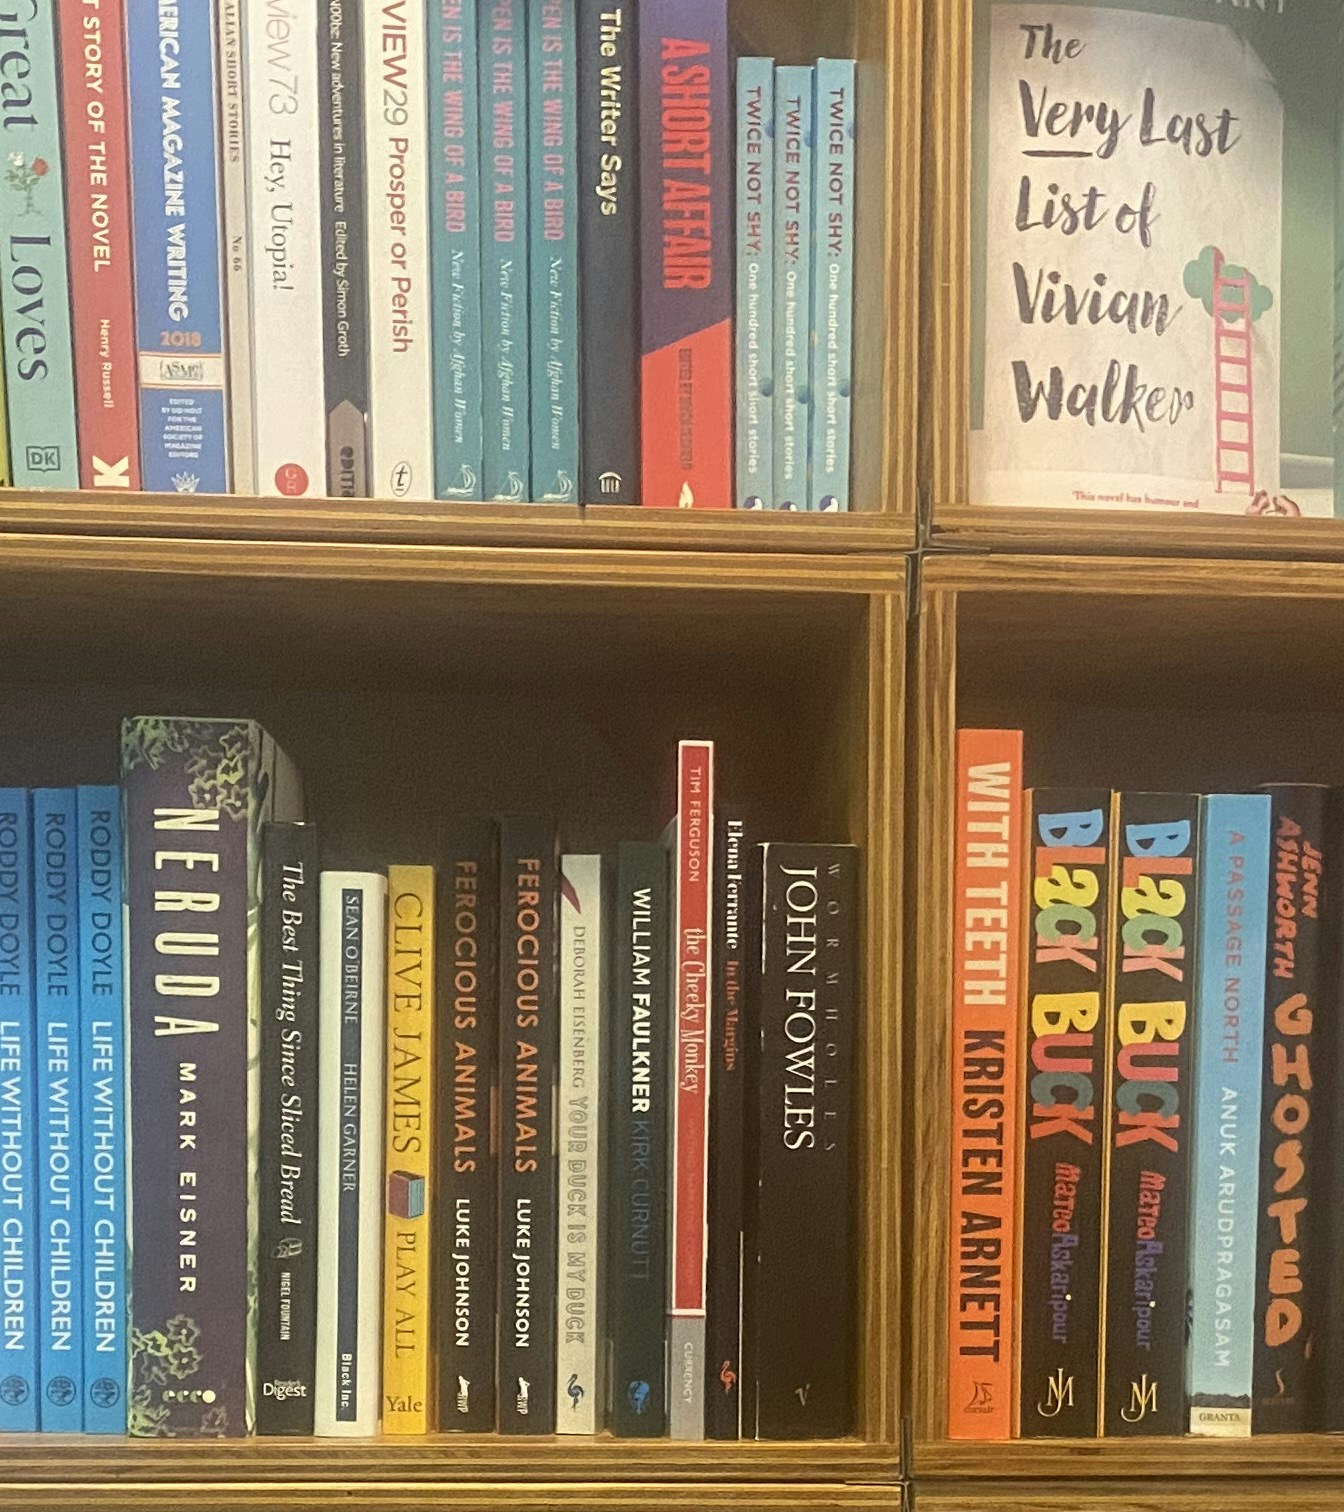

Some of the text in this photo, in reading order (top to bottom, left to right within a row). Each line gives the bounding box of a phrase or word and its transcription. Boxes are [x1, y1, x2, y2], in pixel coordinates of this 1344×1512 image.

[595, 10, 621, 216] The Writer Says
[1021, 23, 1087, 63] The
[1021, 79, 1241, 159] Very Last
[83, 17, 112, 272] STORY OF THE NOVEL
[267, 138, 296, 293] Hey, Utopia!
[827, 87, 845, 258] TWICE NOT SHY:
[1014, 176, 1161, 248] List of
[9, 235, 50, 382] Loves
[387, 138, 414, 354] Prosper Perish
[1011, 262, 1184, 335] Vivian
[1011, 358, 1195, 432] Walker
[152, 807, 222, 1039] NERUDA
[629, 887, 653, 1115] WILLIAM FAULKNER
[782, 864, 818, 1152] JOHN FOWLES
[392, 891, 422, 1155] CLIVE JAMES
[960, 761, 1012, 1363] WITH TEETH KRISTEN ARNETT
[91, 1021, 117, 1353] LIFE WITHOUT CHILDREN
[178, 1062, 199, 1294] MARK EISNER
[342, 1062, 357, 1192] HELEN GARNER
[1198, 1411, 1243, 1424] GRANTA
